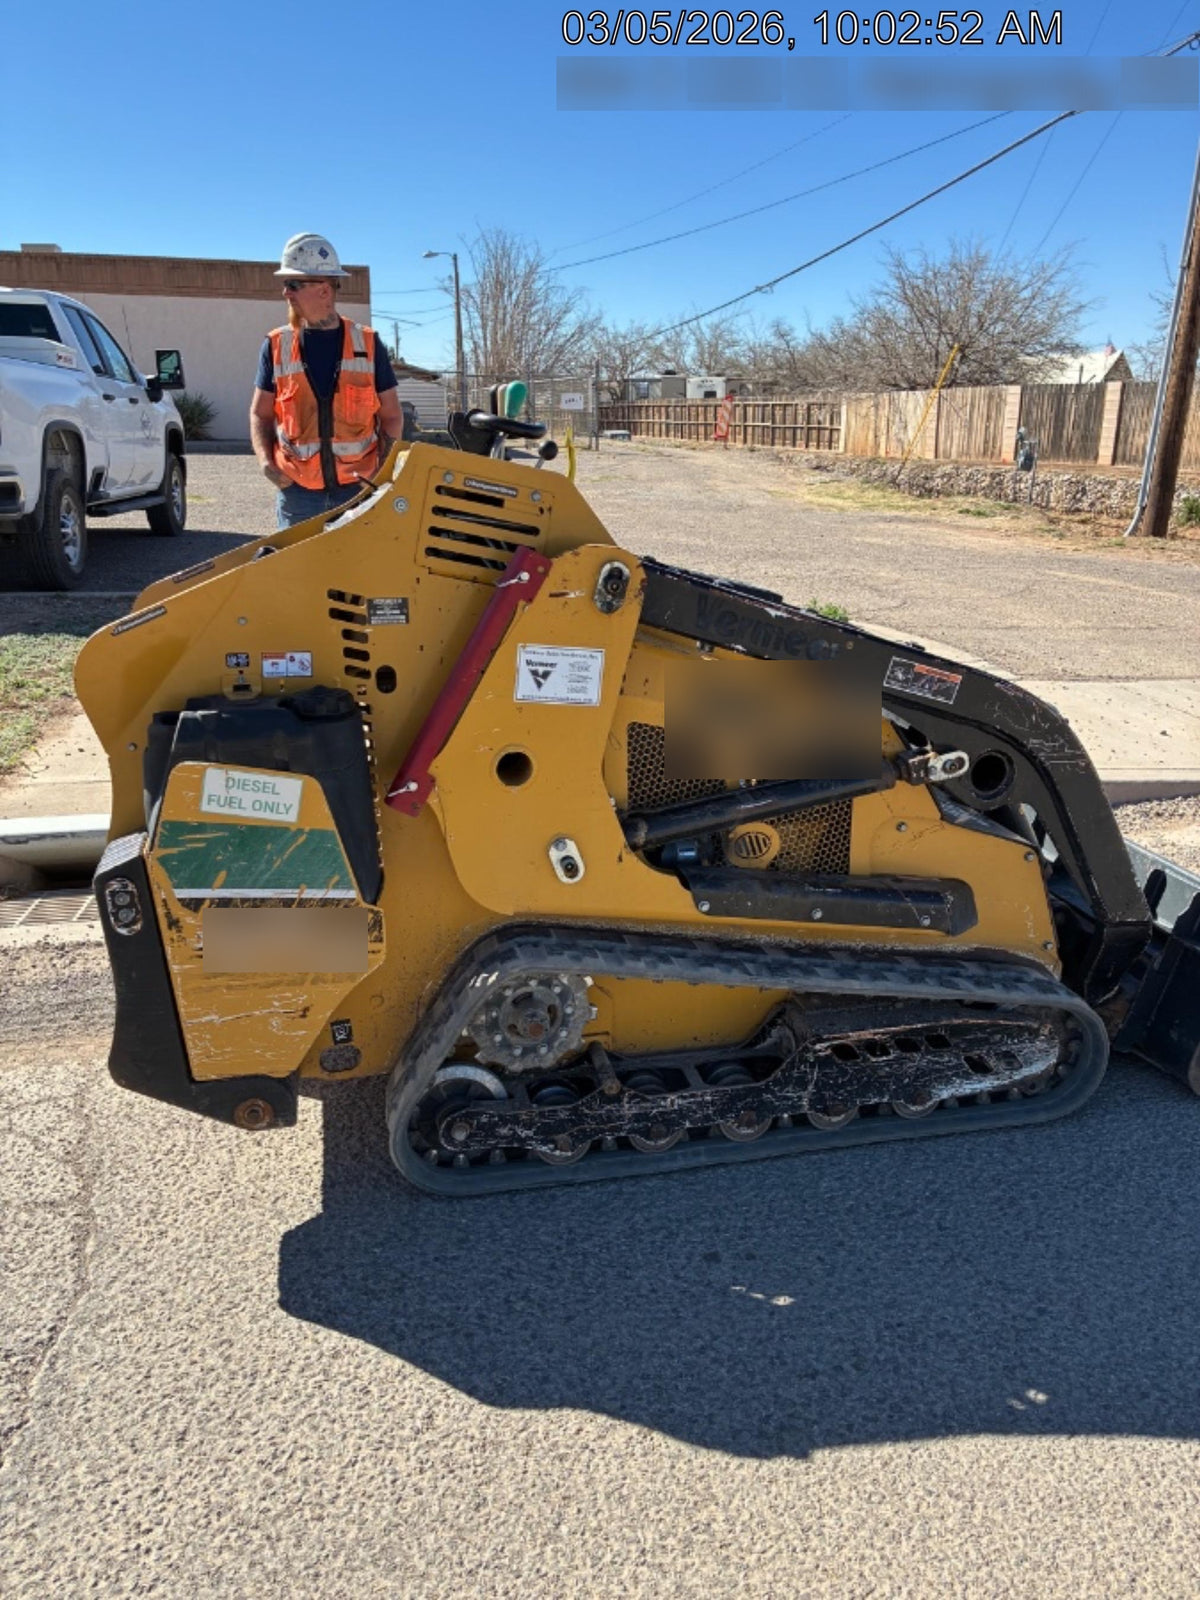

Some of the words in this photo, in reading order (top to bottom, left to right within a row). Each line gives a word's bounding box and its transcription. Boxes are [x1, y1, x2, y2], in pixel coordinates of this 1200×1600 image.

[697, 592, 839, 660] Vermeer
[225, 776, 280, 796] DIESEL
[207, 794, 246, 810] FUEL
[252, 799, 293, 816] ONLY
